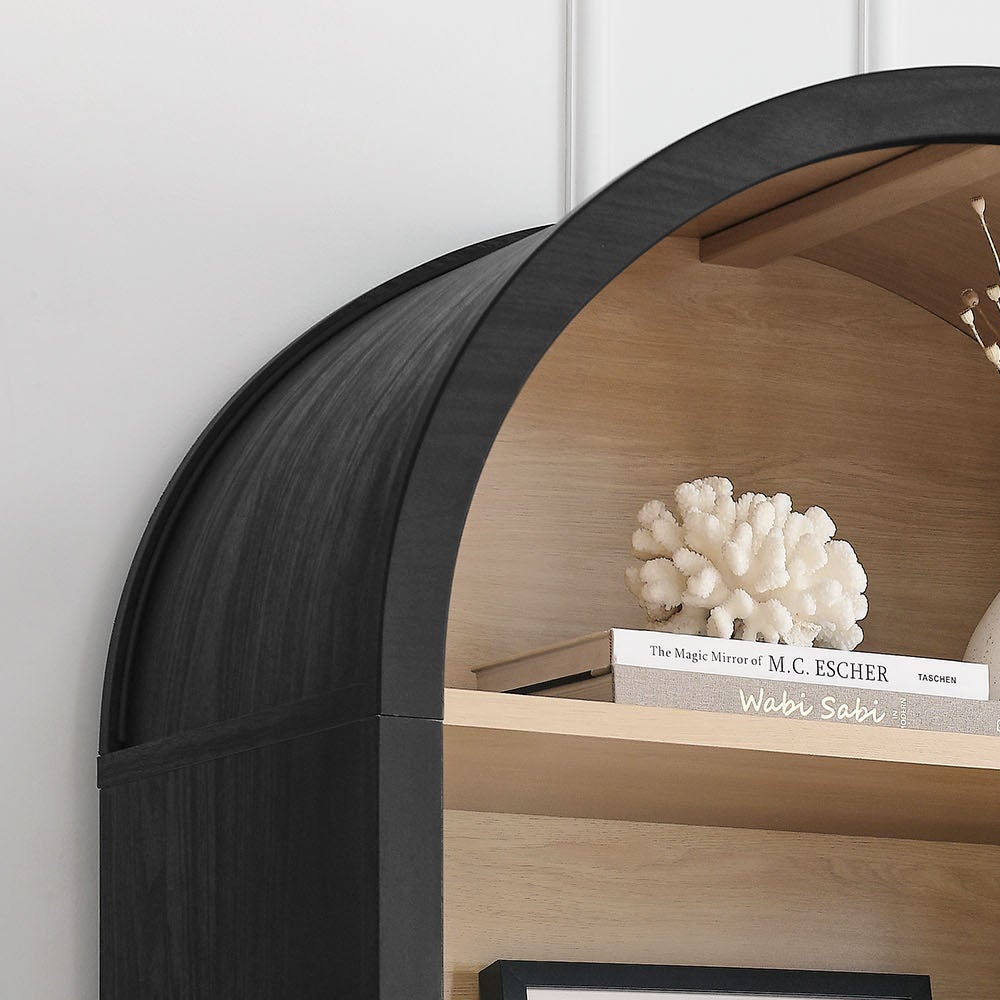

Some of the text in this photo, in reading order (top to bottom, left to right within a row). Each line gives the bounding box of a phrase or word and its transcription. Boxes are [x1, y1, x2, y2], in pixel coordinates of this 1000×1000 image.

[650, 645, 889, 682] The Magic Mirror of M.C. ESCHER
[918, 673, 957, 684] TASCHEN
[739, 688, 887, 723] Wabi Sabi
[892, 710, 898, 719] IN
